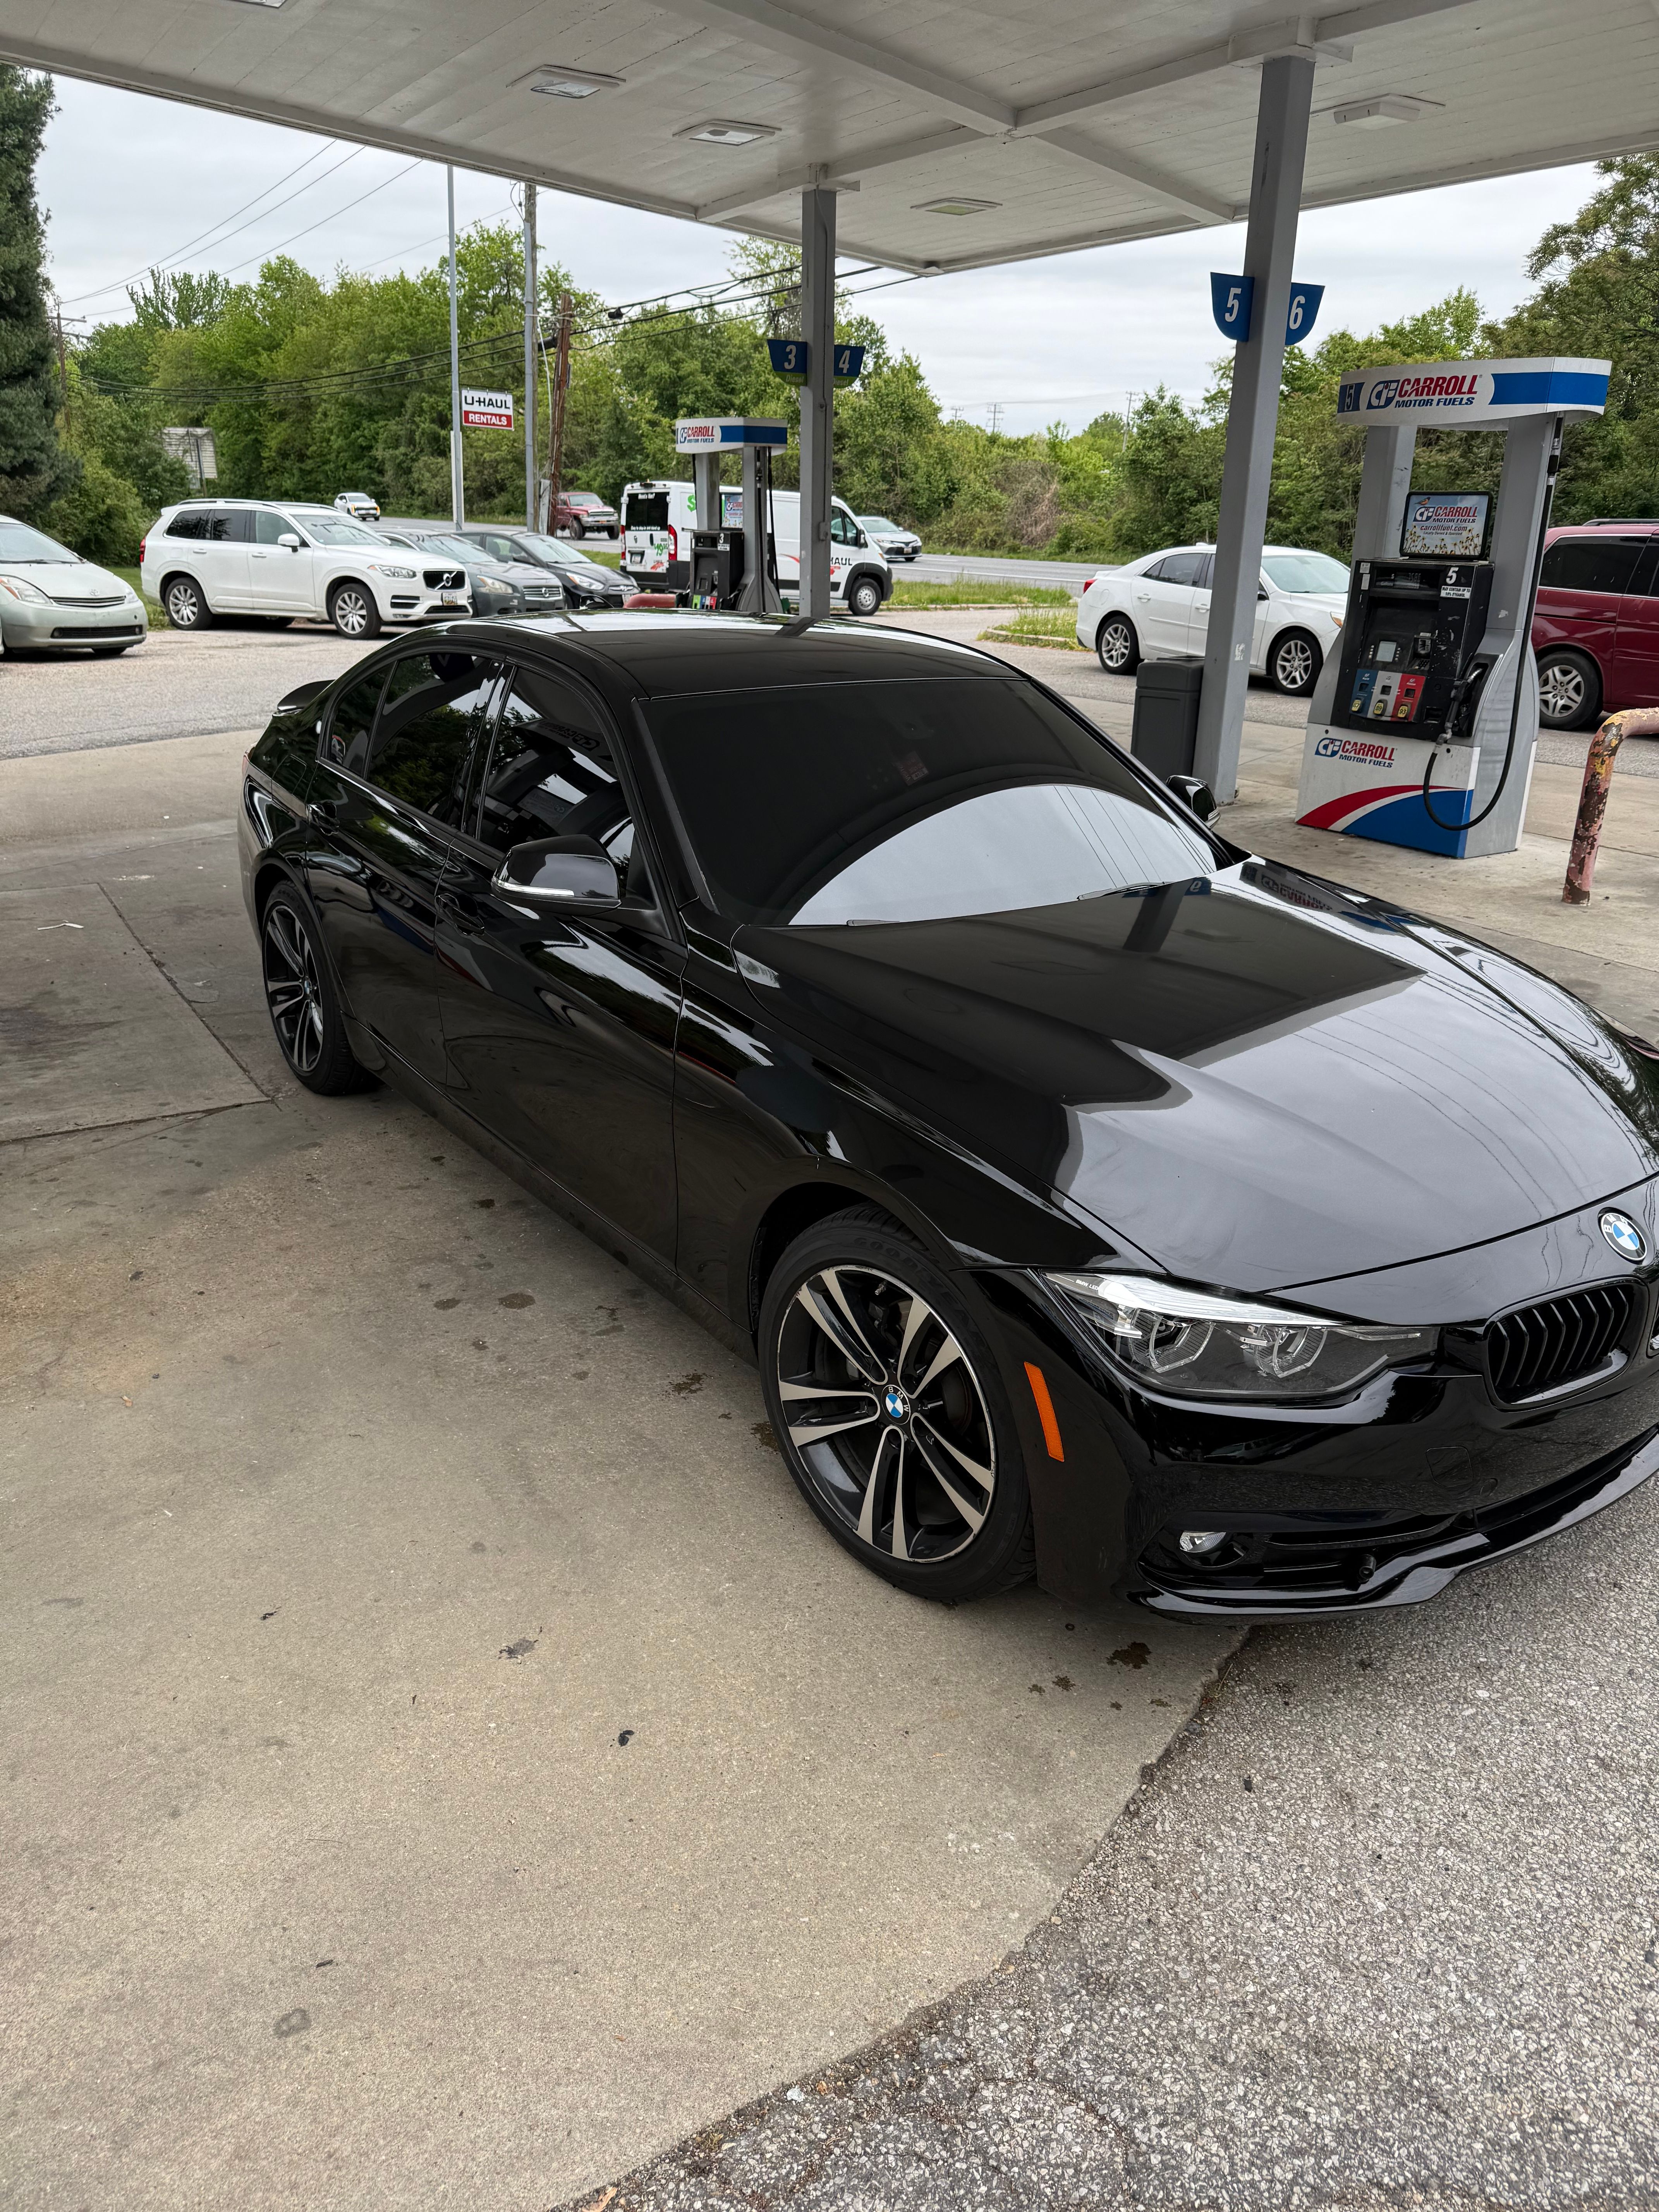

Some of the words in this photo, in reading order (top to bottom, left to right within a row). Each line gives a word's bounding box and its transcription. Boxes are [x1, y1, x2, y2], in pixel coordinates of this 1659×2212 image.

[1225, 287, 1242, 322] 5
[1289, 295, 1305, 329] 6
[784, 345, 796, 369] 3
[839, 350, 850, 373] 4
[786, 375, 804, 383] Diesel
[1398, 375, 1478, 398] CARROLL
[465, 395, 510, 409] U-HAUL
[1346, 385, 1353, 410] 5
[1395, 399, 1433, 408] MOTOR
[1436, 397, 1475, 406] FUELS
[469, 413, 507, 425] RENTALS
[687, 426, 715, 437] CARROLL
[1435, 506, 1477, 517] CARROLL
[720, 533, 724, 543] 3
[1446, 567, 1459, 584] 5
[1341, 740, 1395, 761] CARROLL
[1339, 754, 1367, 764] MOTOR
[1369, 759, 1393, 768] FUELS
[1603, 1214, 1628, 1233] BMW
[888, 1386, 909, 1412] BMW
